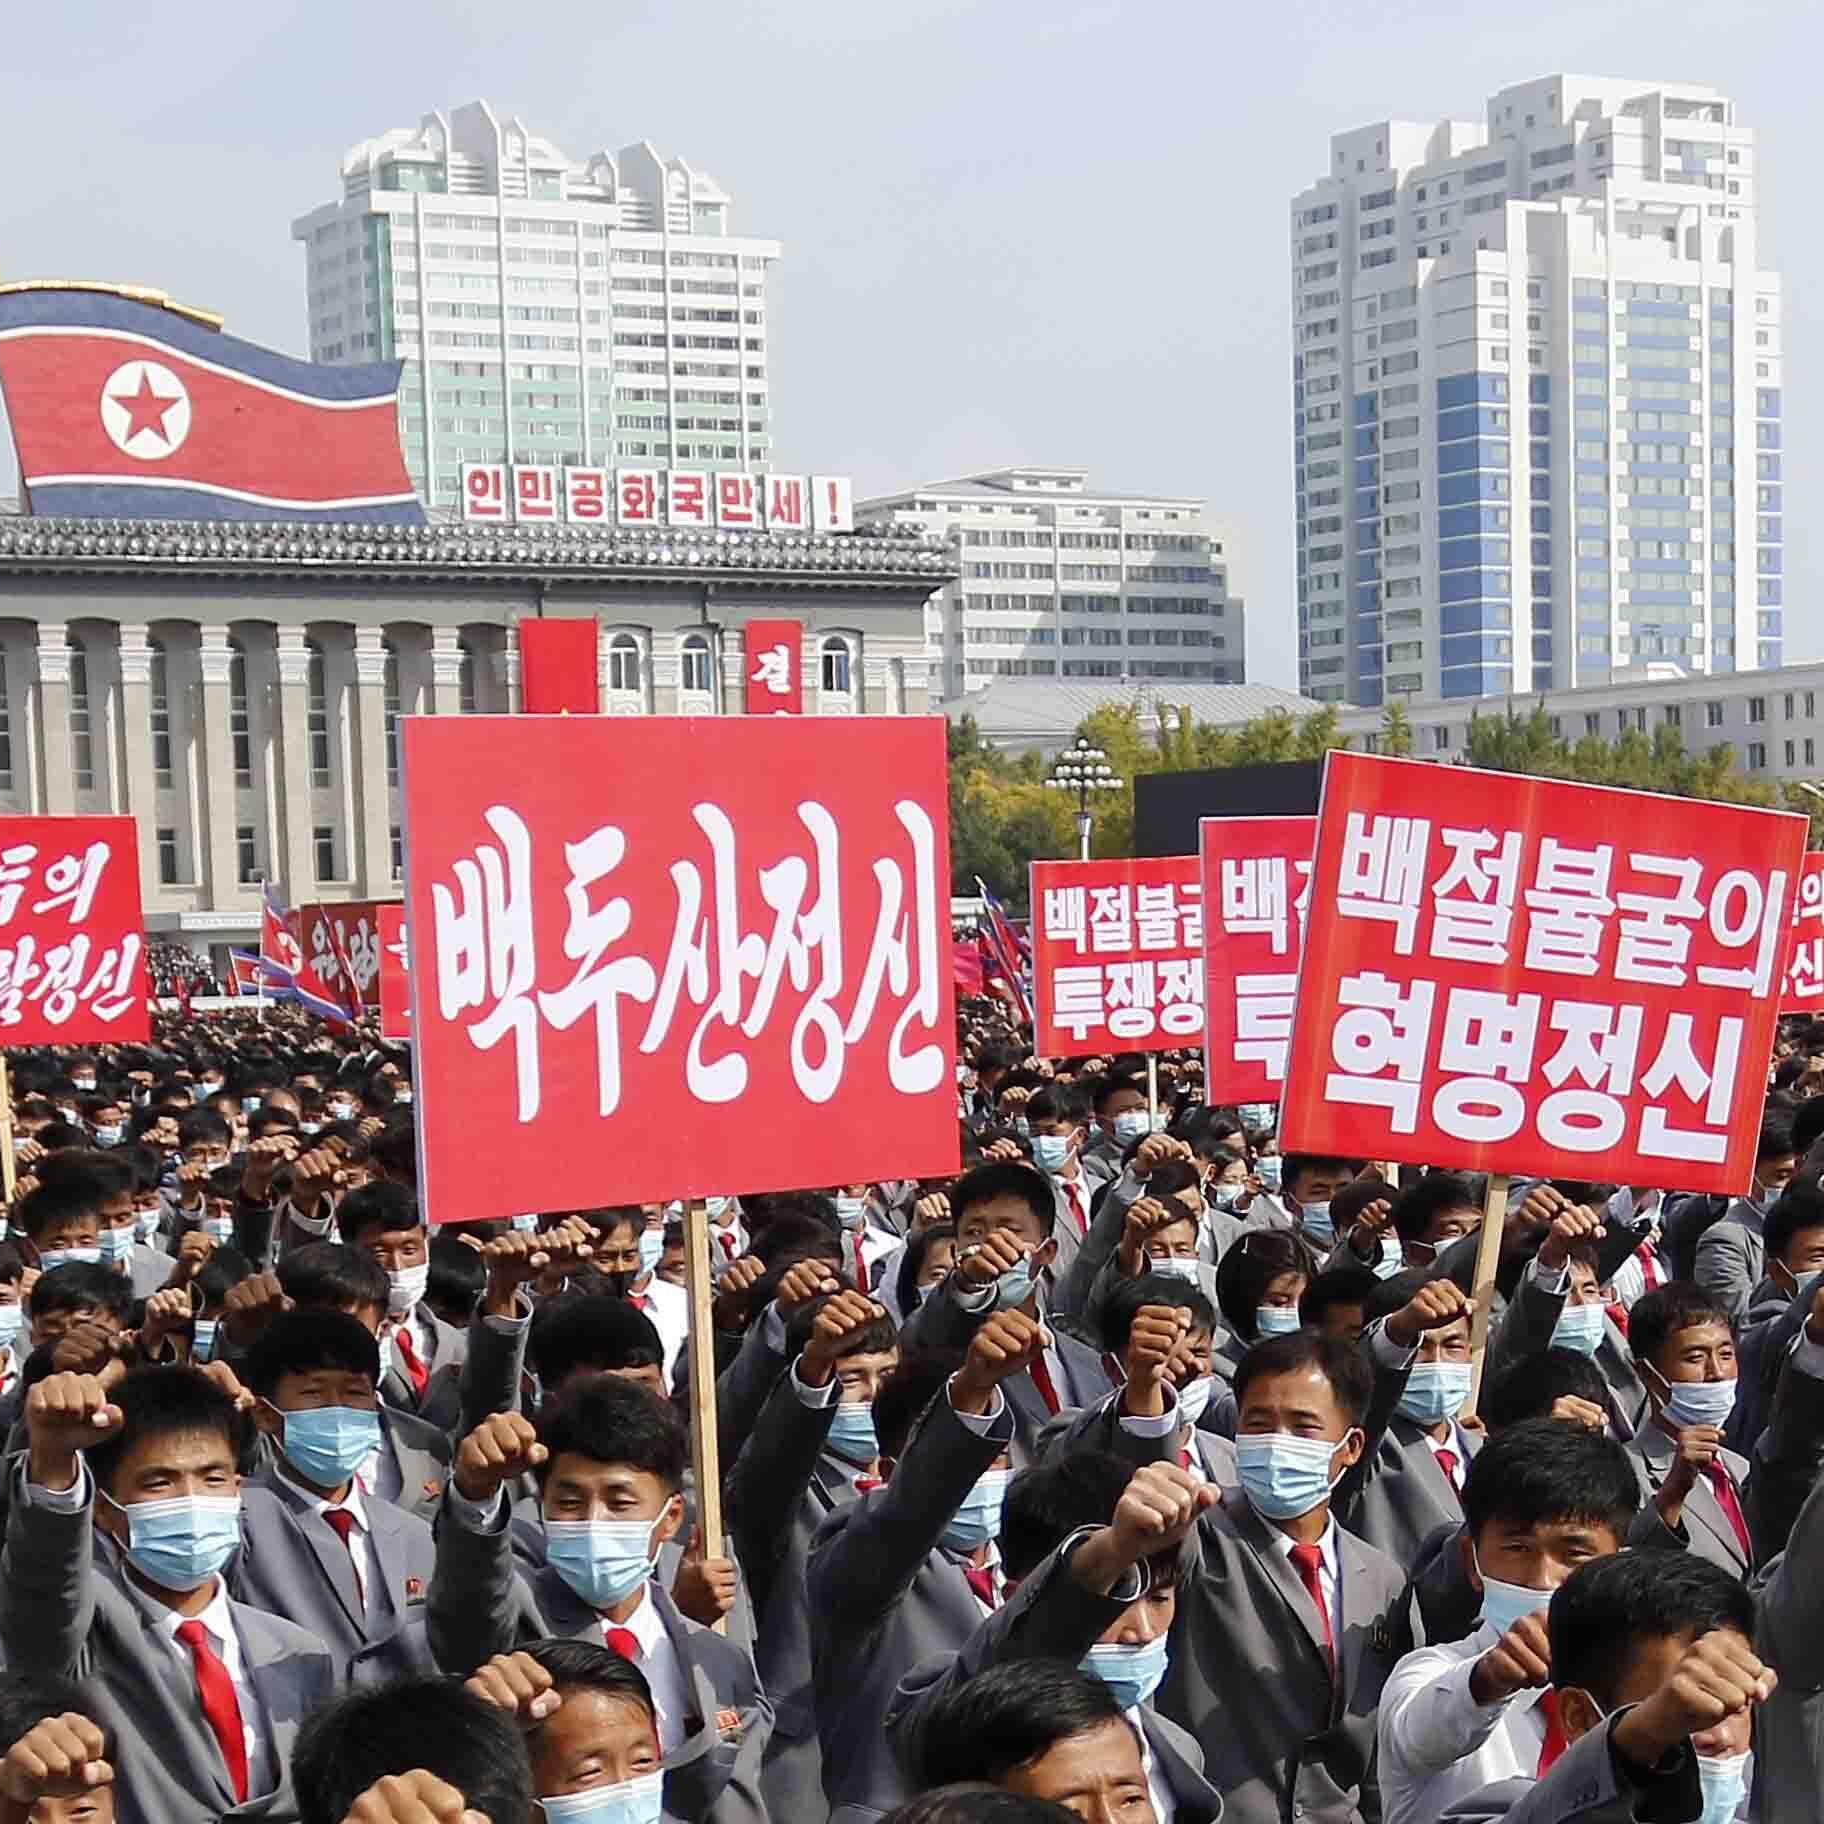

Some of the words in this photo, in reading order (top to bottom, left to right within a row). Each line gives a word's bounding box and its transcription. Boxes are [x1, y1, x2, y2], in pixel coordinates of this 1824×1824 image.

[432, 800, 945, 1123] 백두산정신
[1336, 811, 1785, 999] 백절불굴의
[1324, 972, 1744, 1164] 혁명정신
